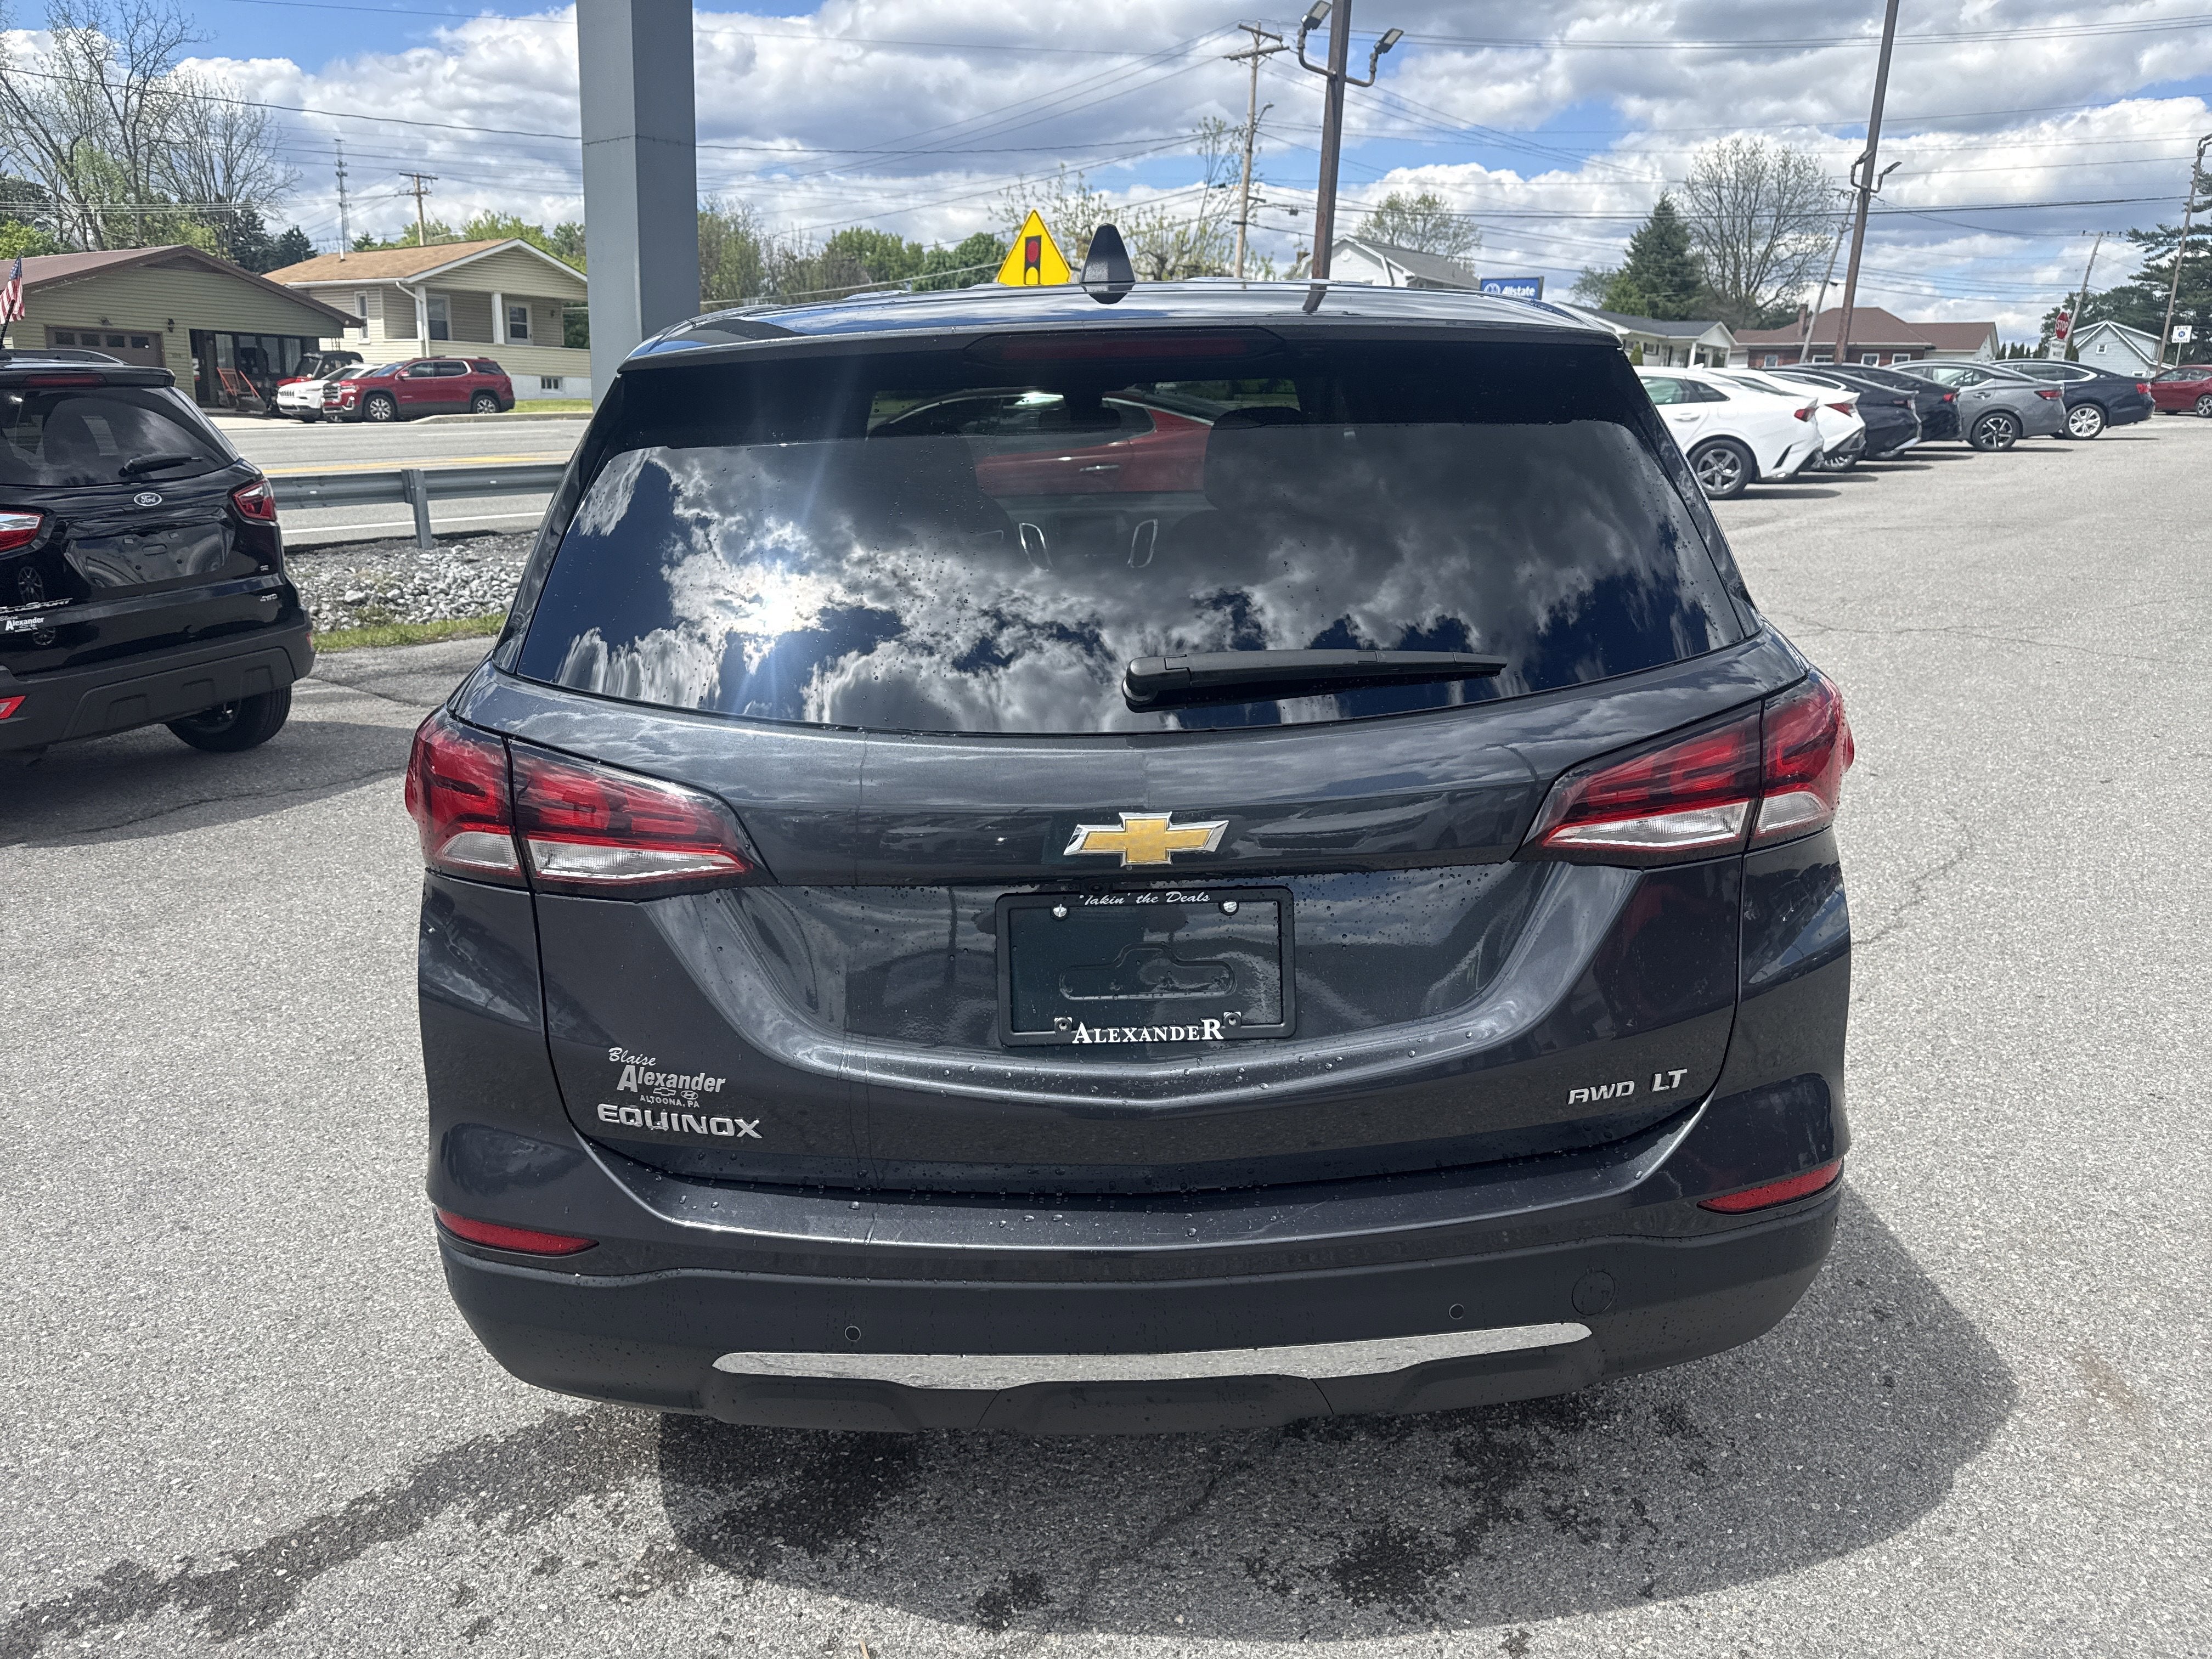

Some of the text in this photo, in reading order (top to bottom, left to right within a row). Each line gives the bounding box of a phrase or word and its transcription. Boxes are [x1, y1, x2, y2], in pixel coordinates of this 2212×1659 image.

[1501, 285, 1536, 296] Allstate
[2056, 319, 2069, 332] STOP
[140, 495, 156, 503] Ford
[5, 617, 44, 631] Alexander
[1136, 893, 1159, 904] the
[1165, 891, 1210, 903] Deals
[1072, 1019, 1224, 1043] ALEXANDER
[608, 1047, 656, 1066] Blaise
[617, 1064, 726, 1092] Alexander
[1567, 1069, 1688, 1105] AWD LT
[640, 1094, 700, 1109] ALTOONA, PA
[597, 1103, 763, 1139] EQUINOX
